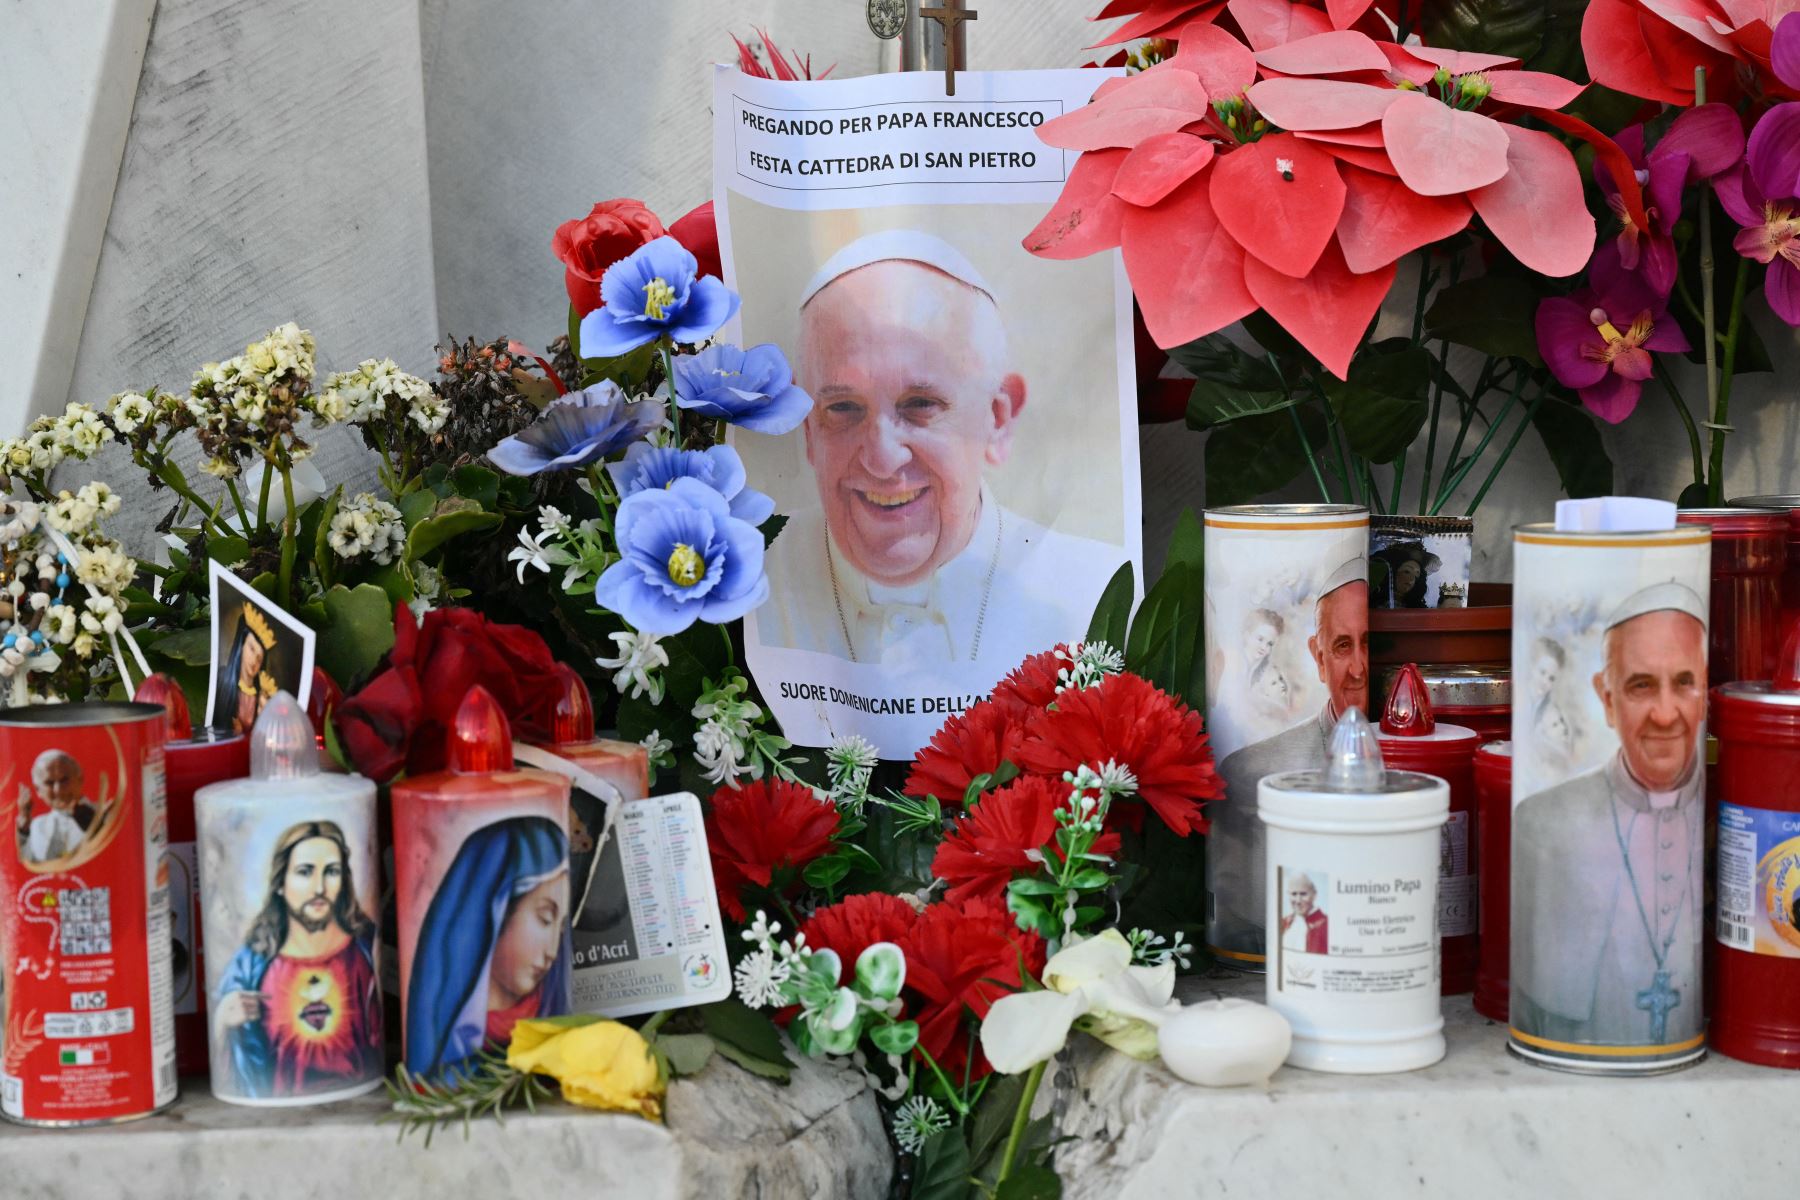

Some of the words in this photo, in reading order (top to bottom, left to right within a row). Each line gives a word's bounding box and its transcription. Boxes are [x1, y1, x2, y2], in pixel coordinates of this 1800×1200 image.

[742, 109, 834, 136] PREGANDO
[839, 111, 872, 135] PER
[877, 111, 928, 131] PAPA
[933, 110, 1045, 129] FRANCESCO
[749, 150, 793, 175] FESTA
[798, 149, 894, 176] CATTEDRA
[900, 152, 919, 169] DI
[924, 151, 963, 169] SAN
[969, 151, 1037, 169] PIETRO
[780, 681, 828, 702] SUORE
[830, 686, 916, 716] DOMENICANE
[922, 694, 993, 714] DELL'A
[1337, 879, 1391, 894] Lumino
[1394, 878, 1421, 895] Papa
[588, 940, 630, 962] d'Acri
